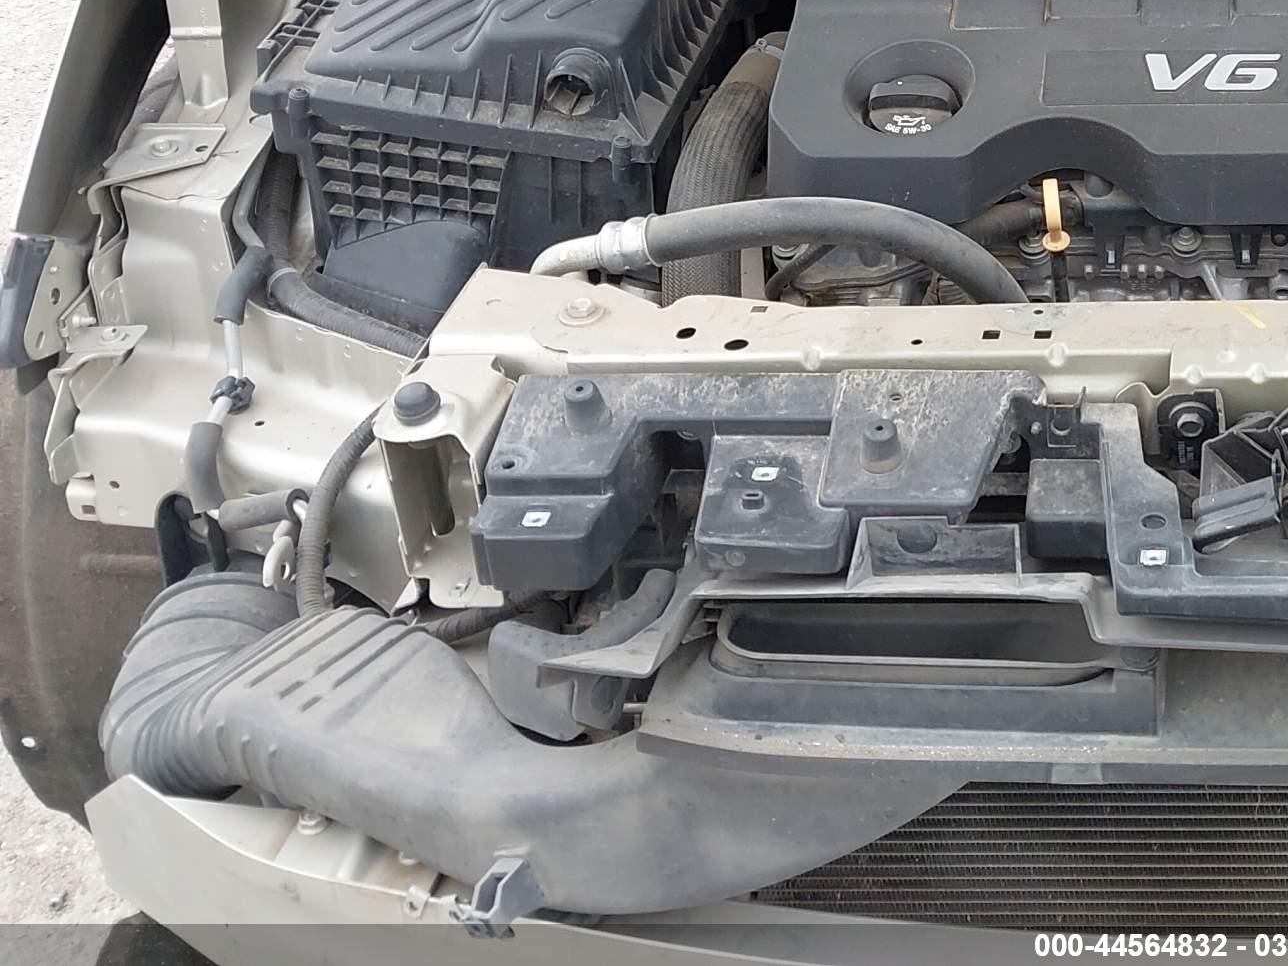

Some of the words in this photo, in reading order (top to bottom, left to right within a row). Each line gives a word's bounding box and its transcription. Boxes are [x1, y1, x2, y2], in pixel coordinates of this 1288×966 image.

[1145, 53, 1281, 91] V6
[885, 123, 901, 134] SAE
[902, 124, 932, 135] 5W-30
